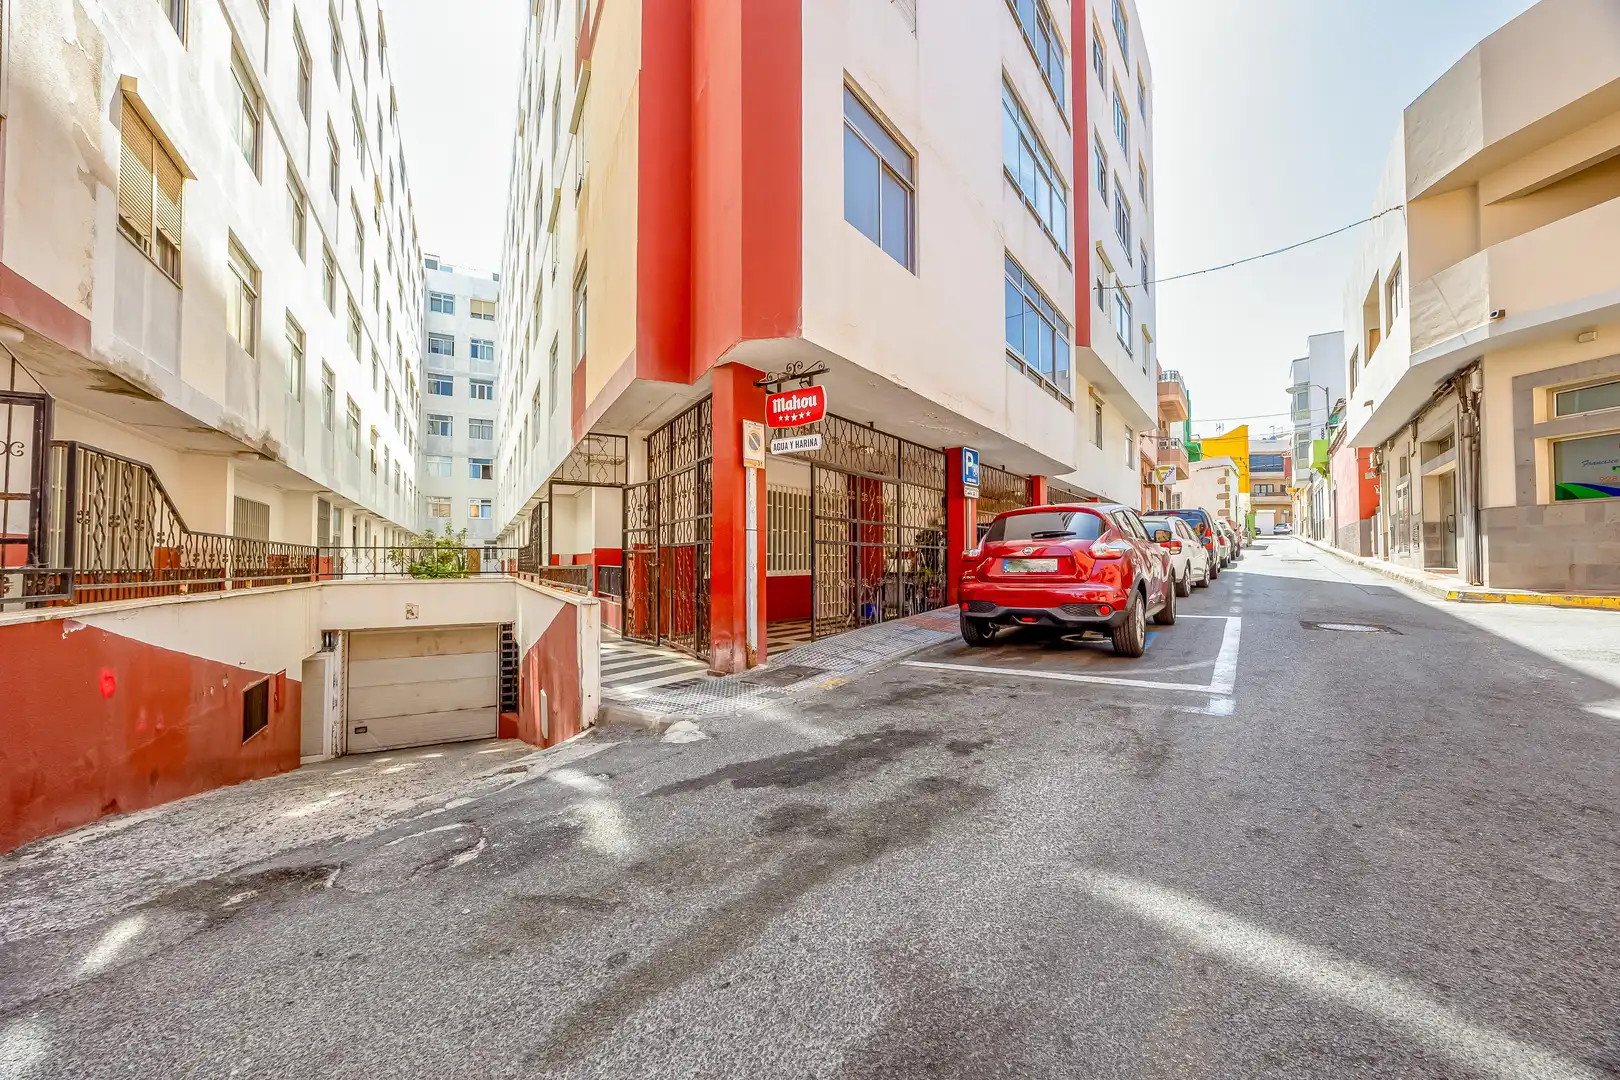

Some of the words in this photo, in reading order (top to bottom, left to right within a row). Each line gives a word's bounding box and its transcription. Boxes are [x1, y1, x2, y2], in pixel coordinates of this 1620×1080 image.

[772, 394, 817, 413] Mahou
[773, 442, 789, 452] AGUA
[789, 440, 795, 450] Y
[795, 437, 818, 449] HARINA
[965, 451, 974, 475] P
